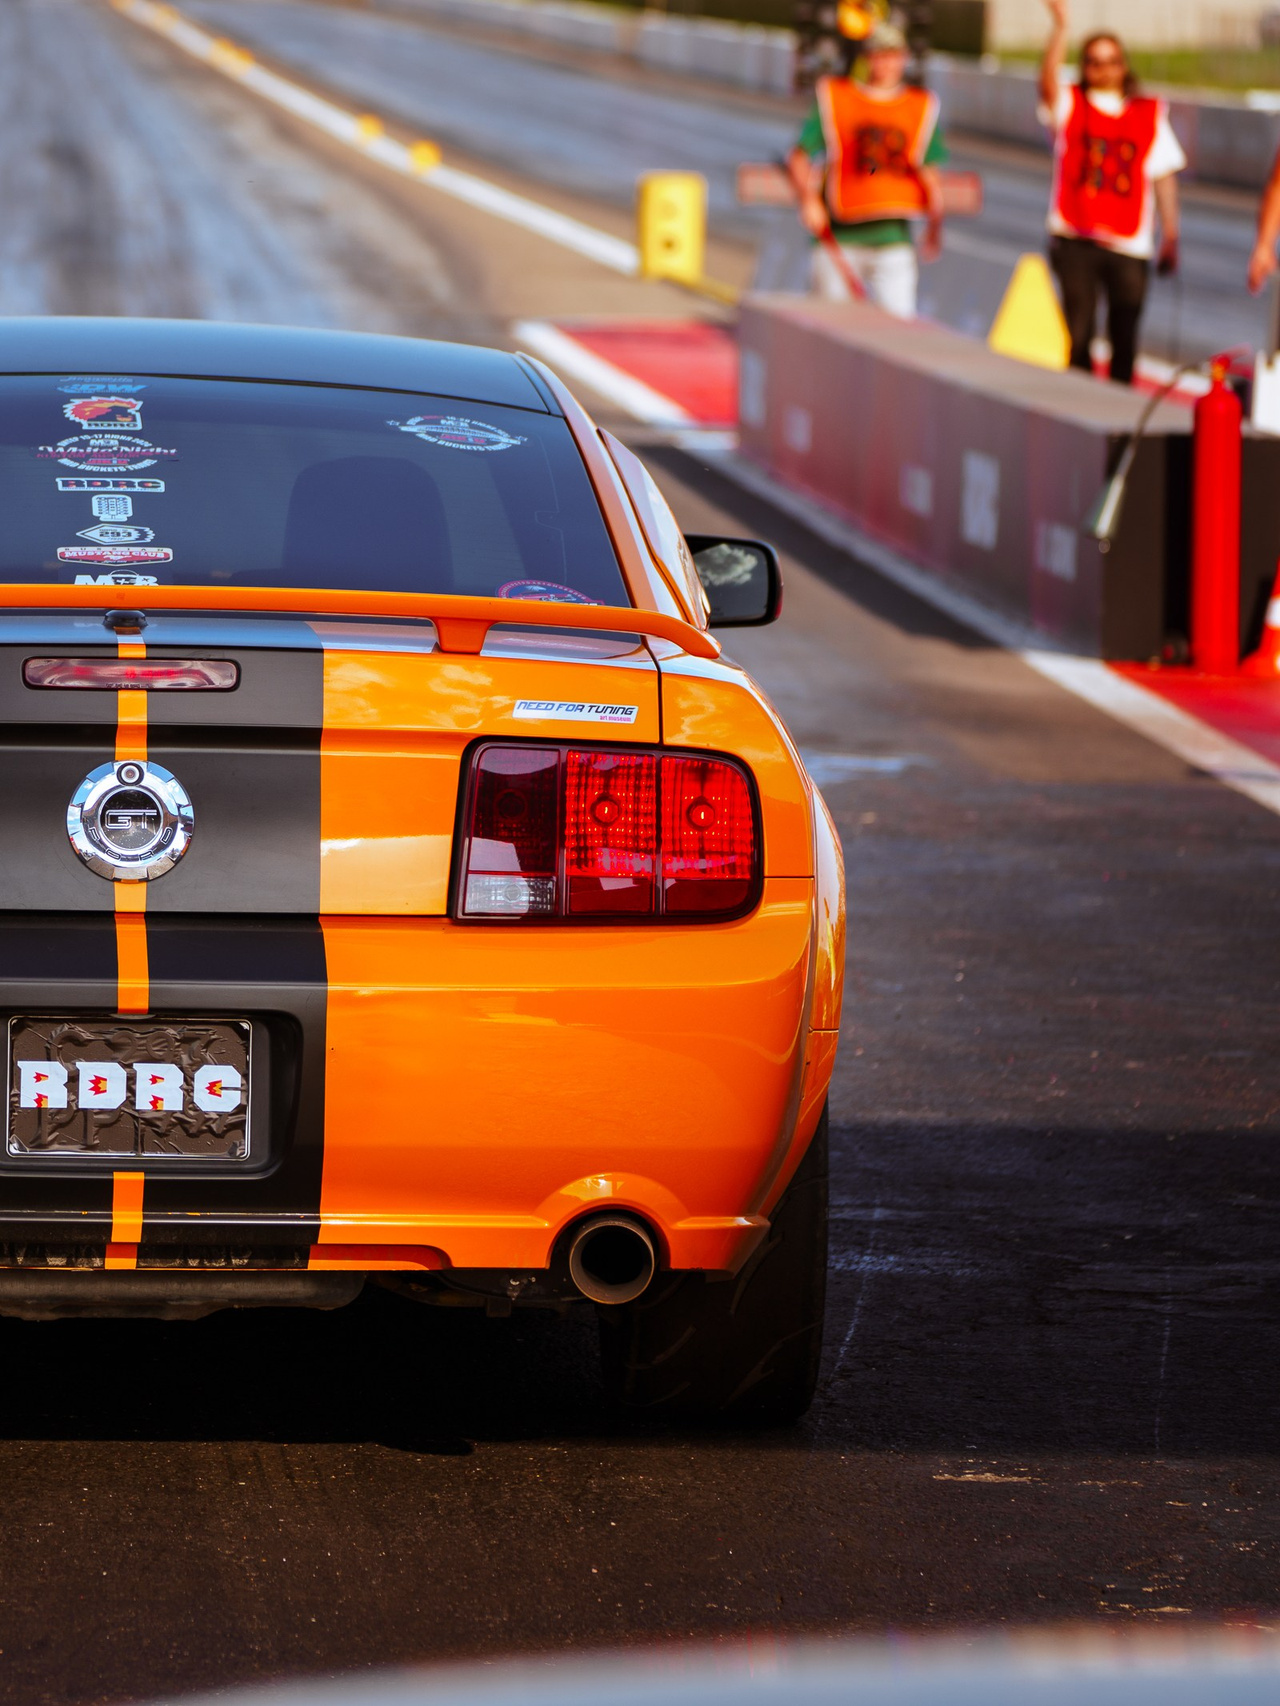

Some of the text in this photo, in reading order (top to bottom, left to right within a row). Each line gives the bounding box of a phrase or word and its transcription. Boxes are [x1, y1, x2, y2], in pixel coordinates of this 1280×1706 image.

[61, 480, 161, 489] RDRC
[516, 701, 636, 716] NEED FOR TUNING
[105, 809, 158, 830] GT
[17, 1060, 242, 1113] RDRC
